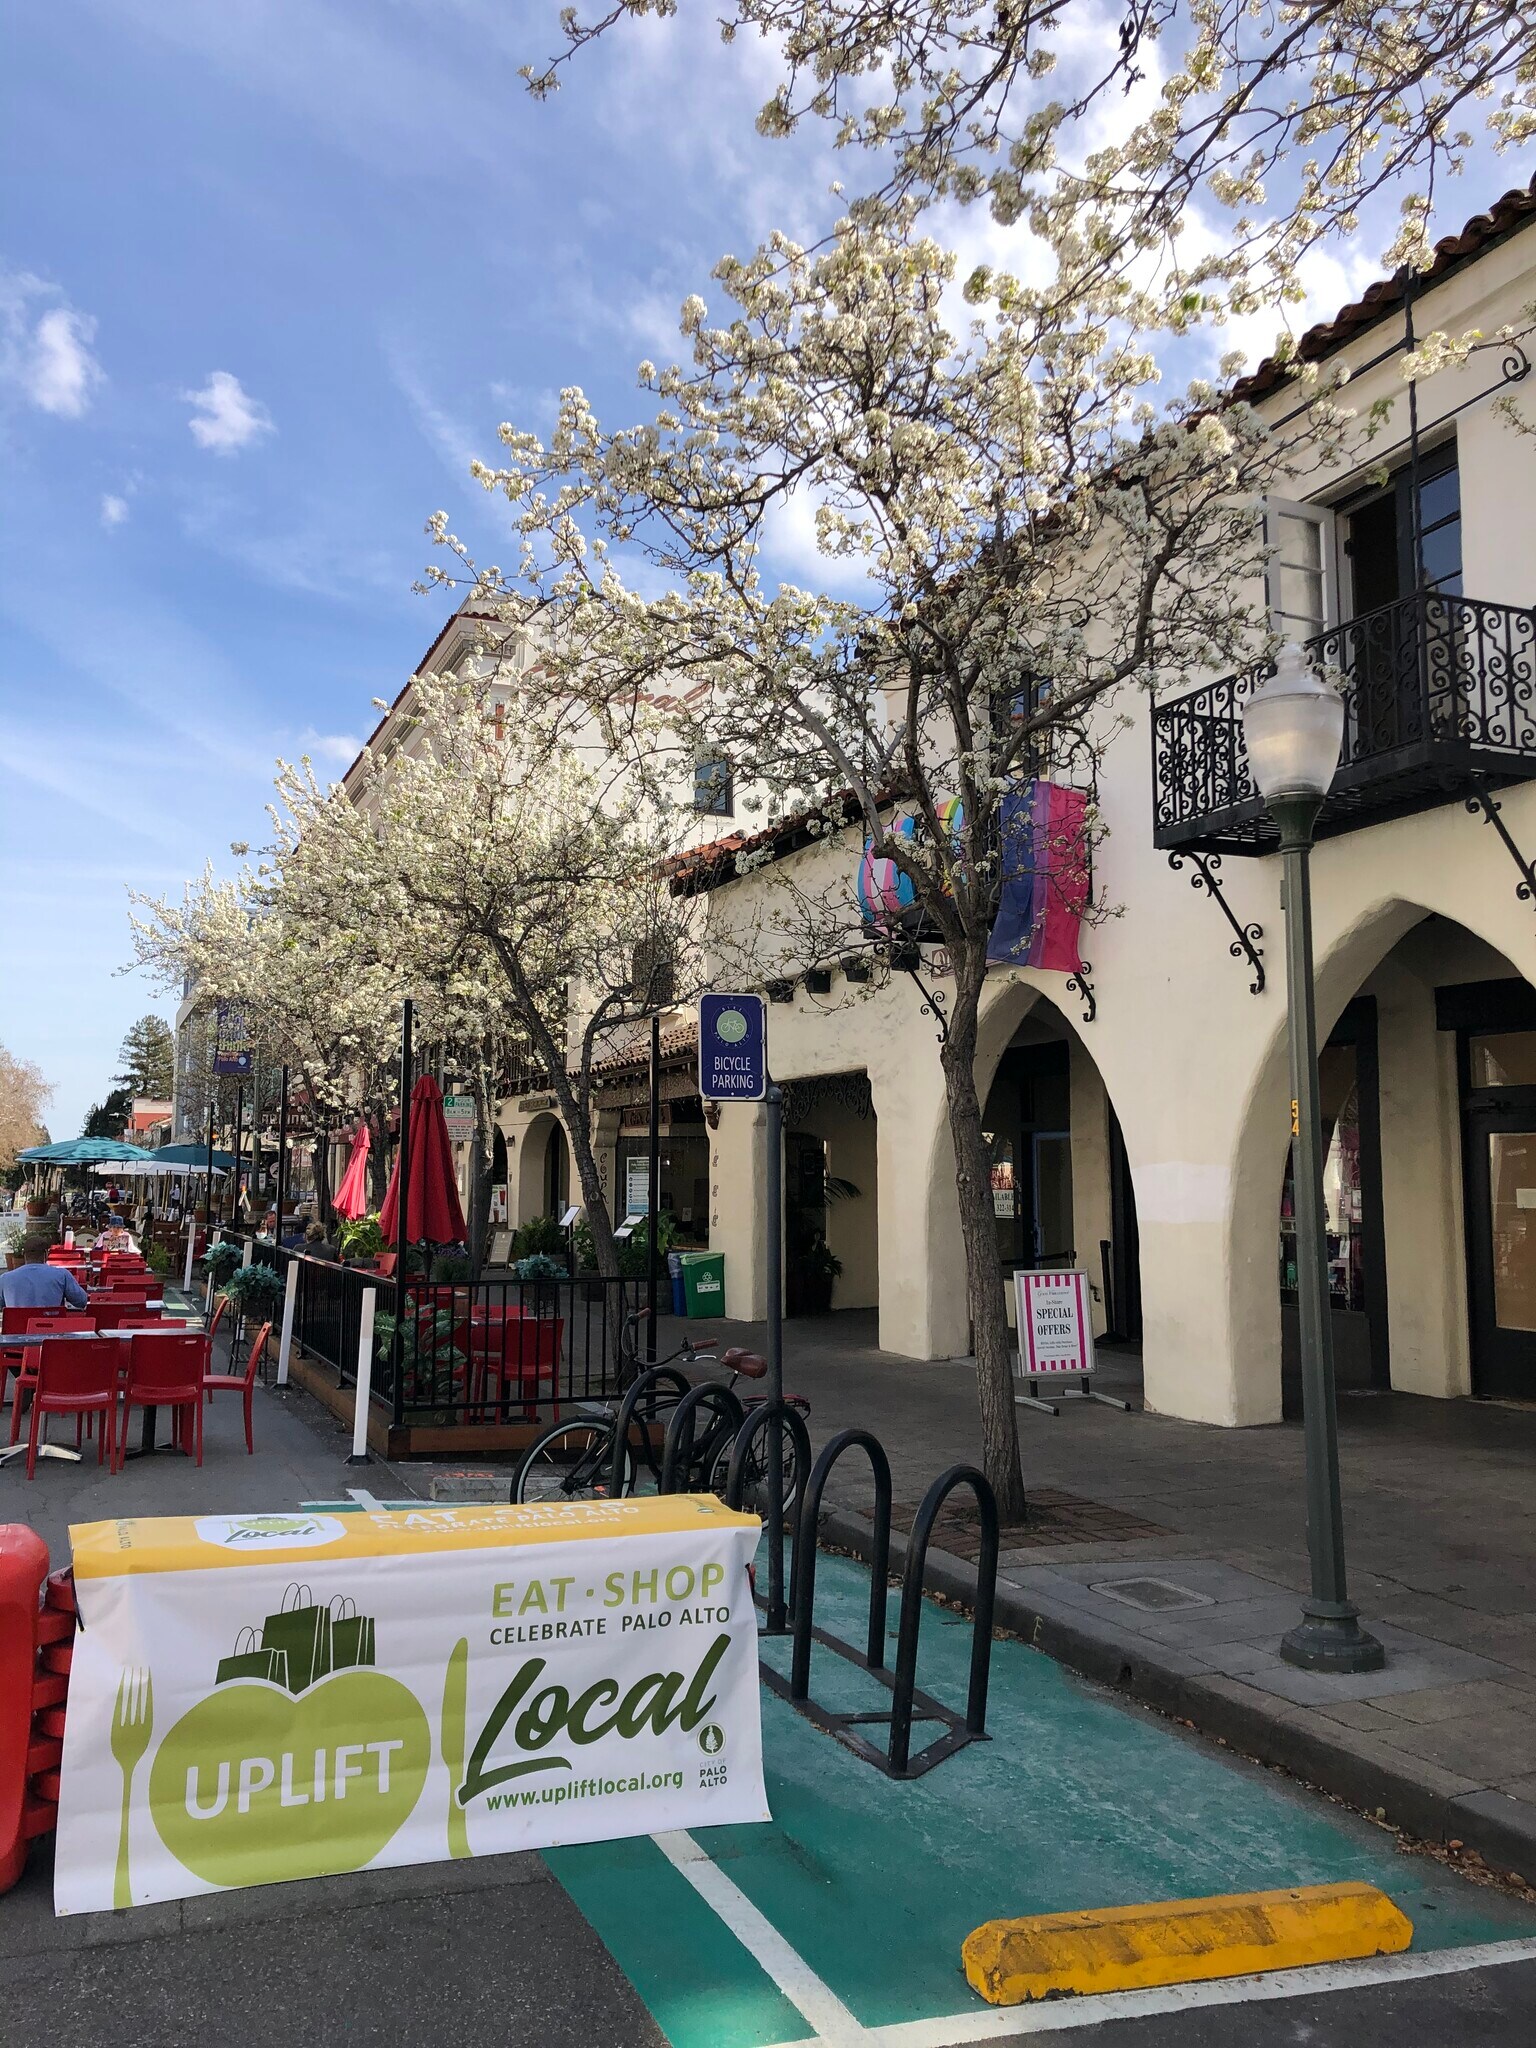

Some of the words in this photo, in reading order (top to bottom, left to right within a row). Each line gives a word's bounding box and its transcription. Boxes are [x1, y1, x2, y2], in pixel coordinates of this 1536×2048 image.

[714, 1056, 751, 1071] BICYCLE
[712, 1074, 754, 1089] PARKING
[447, 1097, 453, 1107] 2
[1036, 1307, 1074, 1320] SPECIAL
[1037, 1323, 1072, 1336] OFFERS
[517, 1511, 575, 1523] PALO
[585, 1507, 640, 1517] ALTO
[224, 1526, 316, 1544] Local
[492, 1576, 576, 1618] EAT
[603, 1563, 725, 1608] SHOP
[490, 1617, 607, 1646] CELEBRATE
[621, 1610, 672, 1633] PALO
[679, 1606, 730, 1626] ALTO
[458, 1633, 732, 1806] Local
[699, 1759, 716, 1768] CITY
[699, 1765, 727, 1778] PALO
[184, 1738, 405, 1822] UPLIFT
[699, 1775, 728, 1789] ALTO
[486, 1770, 684, 1811] www.upliftlocal.org
